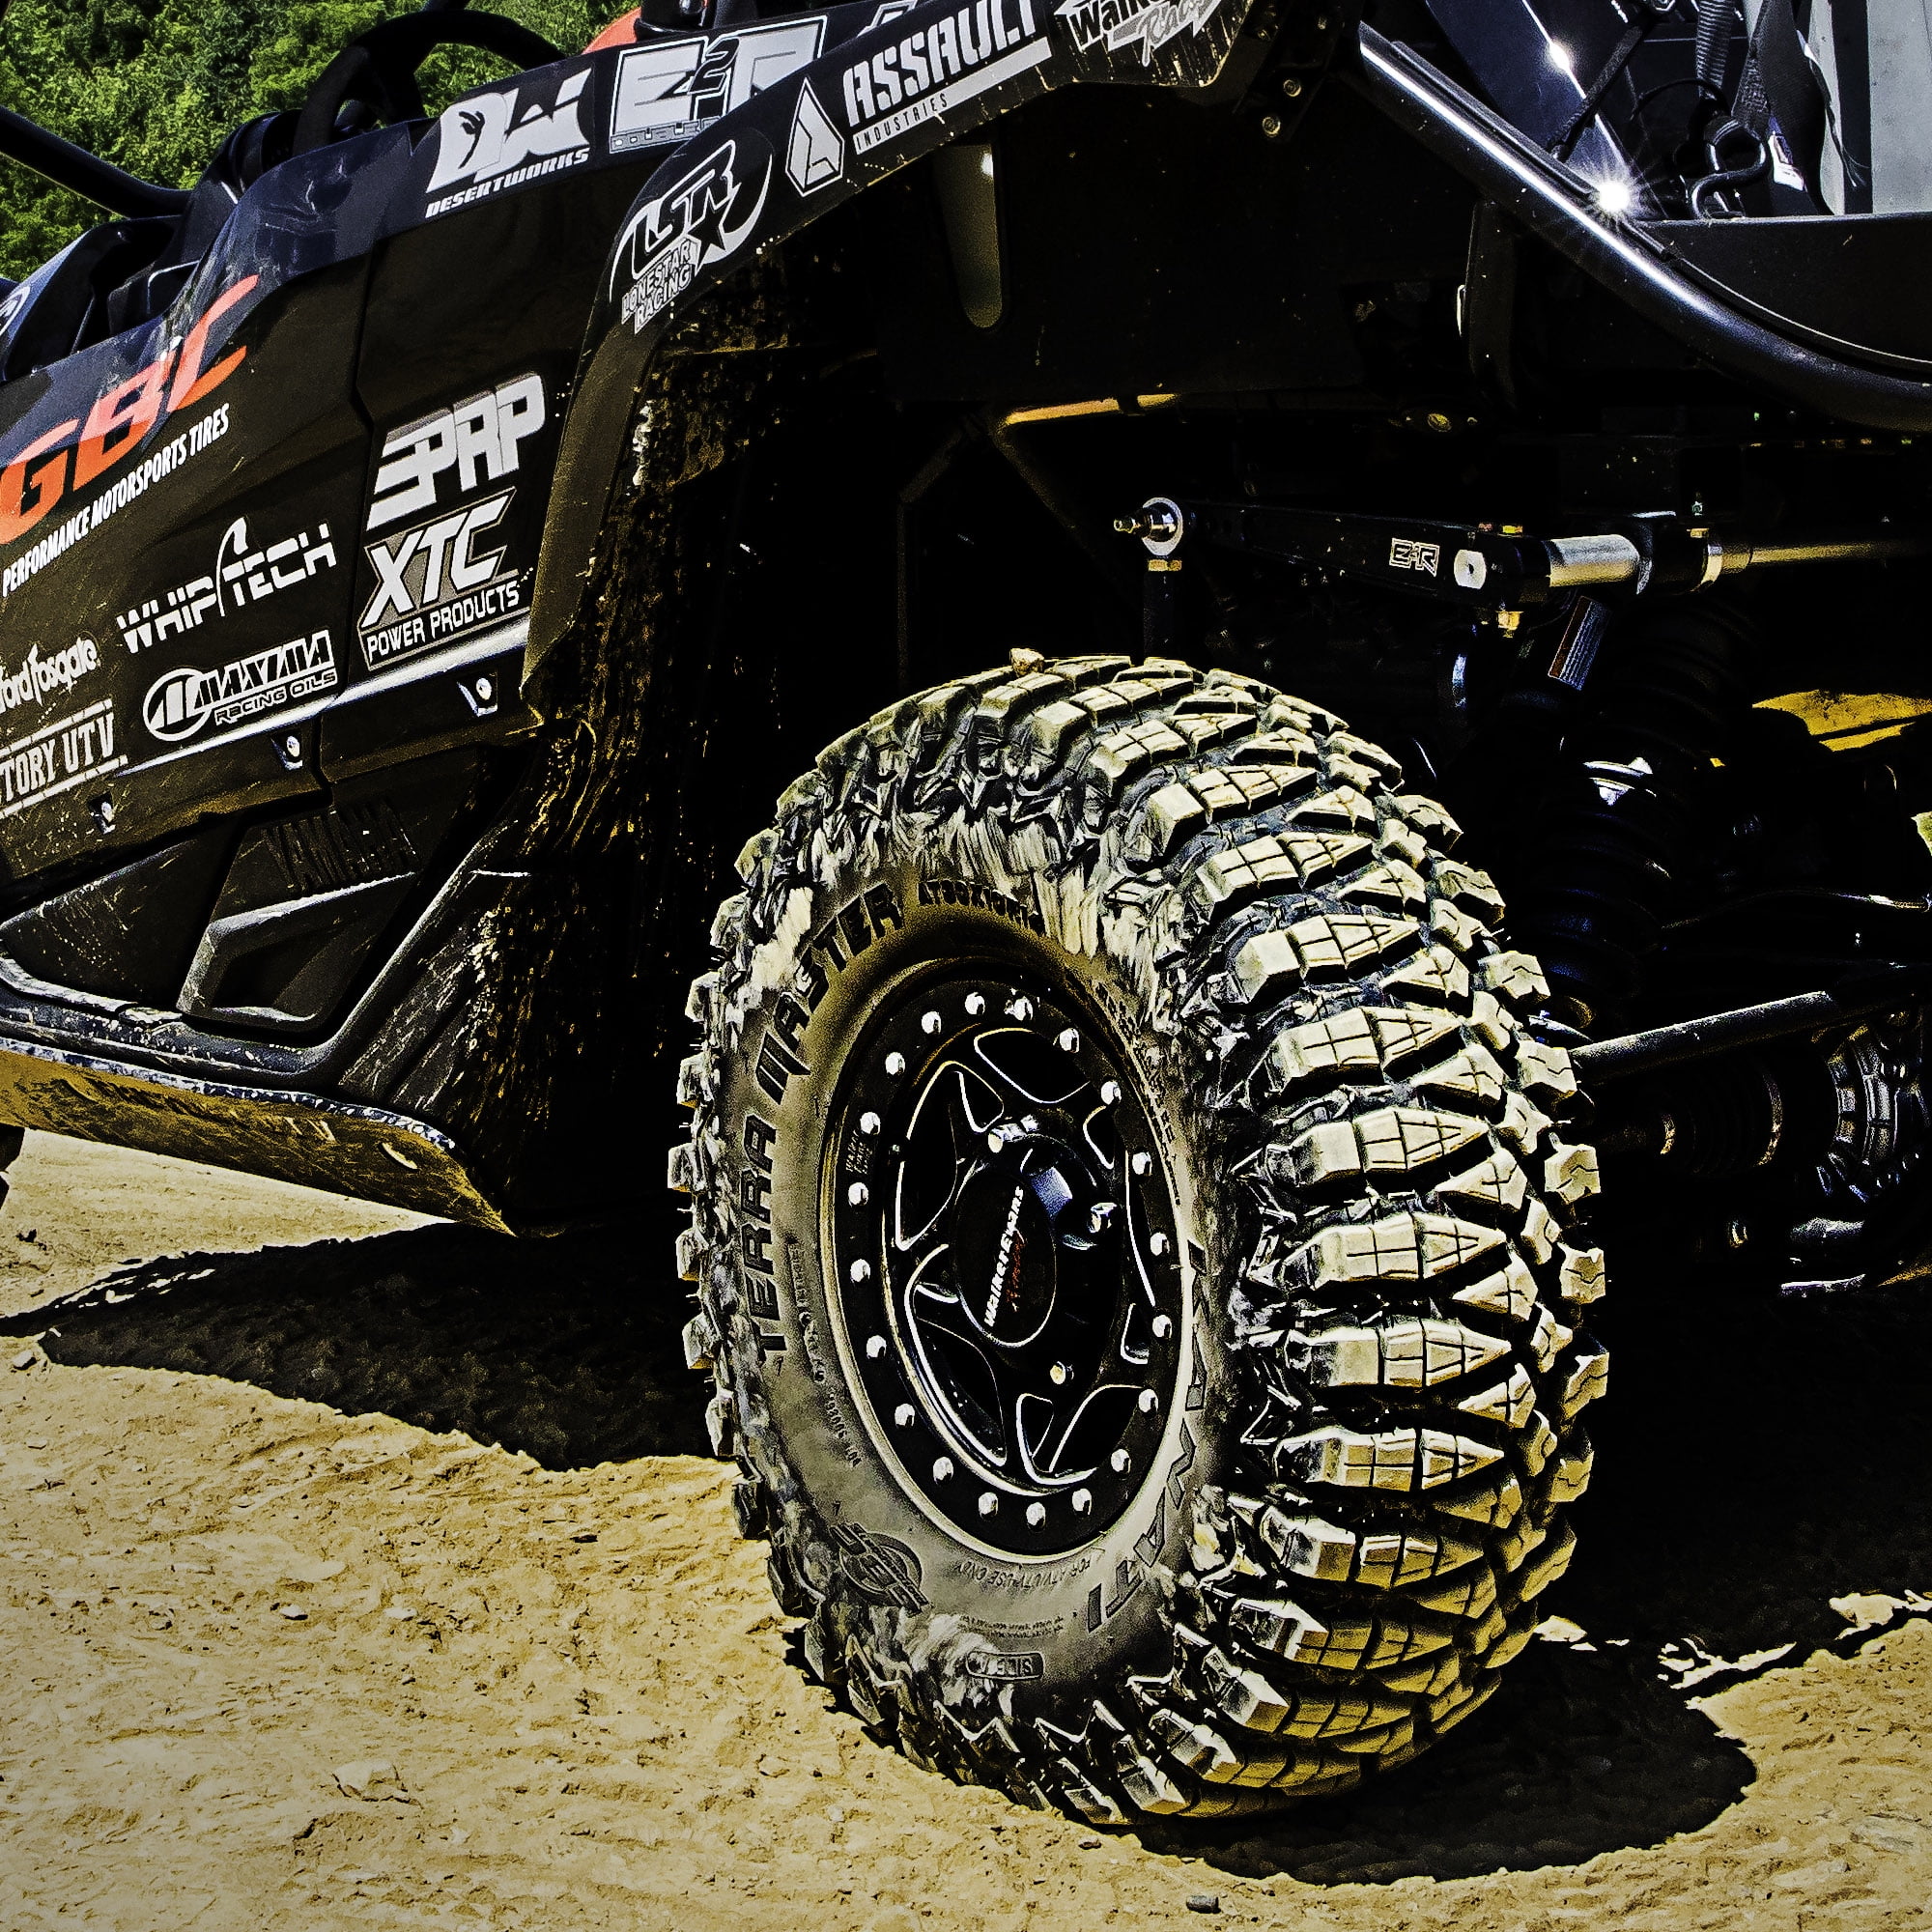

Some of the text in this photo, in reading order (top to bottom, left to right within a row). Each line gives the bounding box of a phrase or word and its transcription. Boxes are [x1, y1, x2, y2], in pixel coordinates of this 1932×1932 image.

[843, 0, 1037, 128] ASSAULT
[855, 93, 948, 151] INDUSTRIES
[425, 148, 590, 218] DESERTWORKS
[622, 240, 692, 323] LONESTAR
[635, 263, 693, 335] RACING
[0, 274, 259, 544] GBC
[2, 403, 230, 597] PERFORMANCE MOTORSPORTS TIRES
[360, 495, 509, 629] XTC
[366, 580, 521, 664] POWER PRODUCTS
[190, 630, 335, 715] MAXIMA
[214, 668, 337, 725] RACING OILS
[62, 712, 115, 773] UTV
[741, 883, 904, 1367] TERRA MASTER
[1087, 1238, 1210, 1633] KANATI
